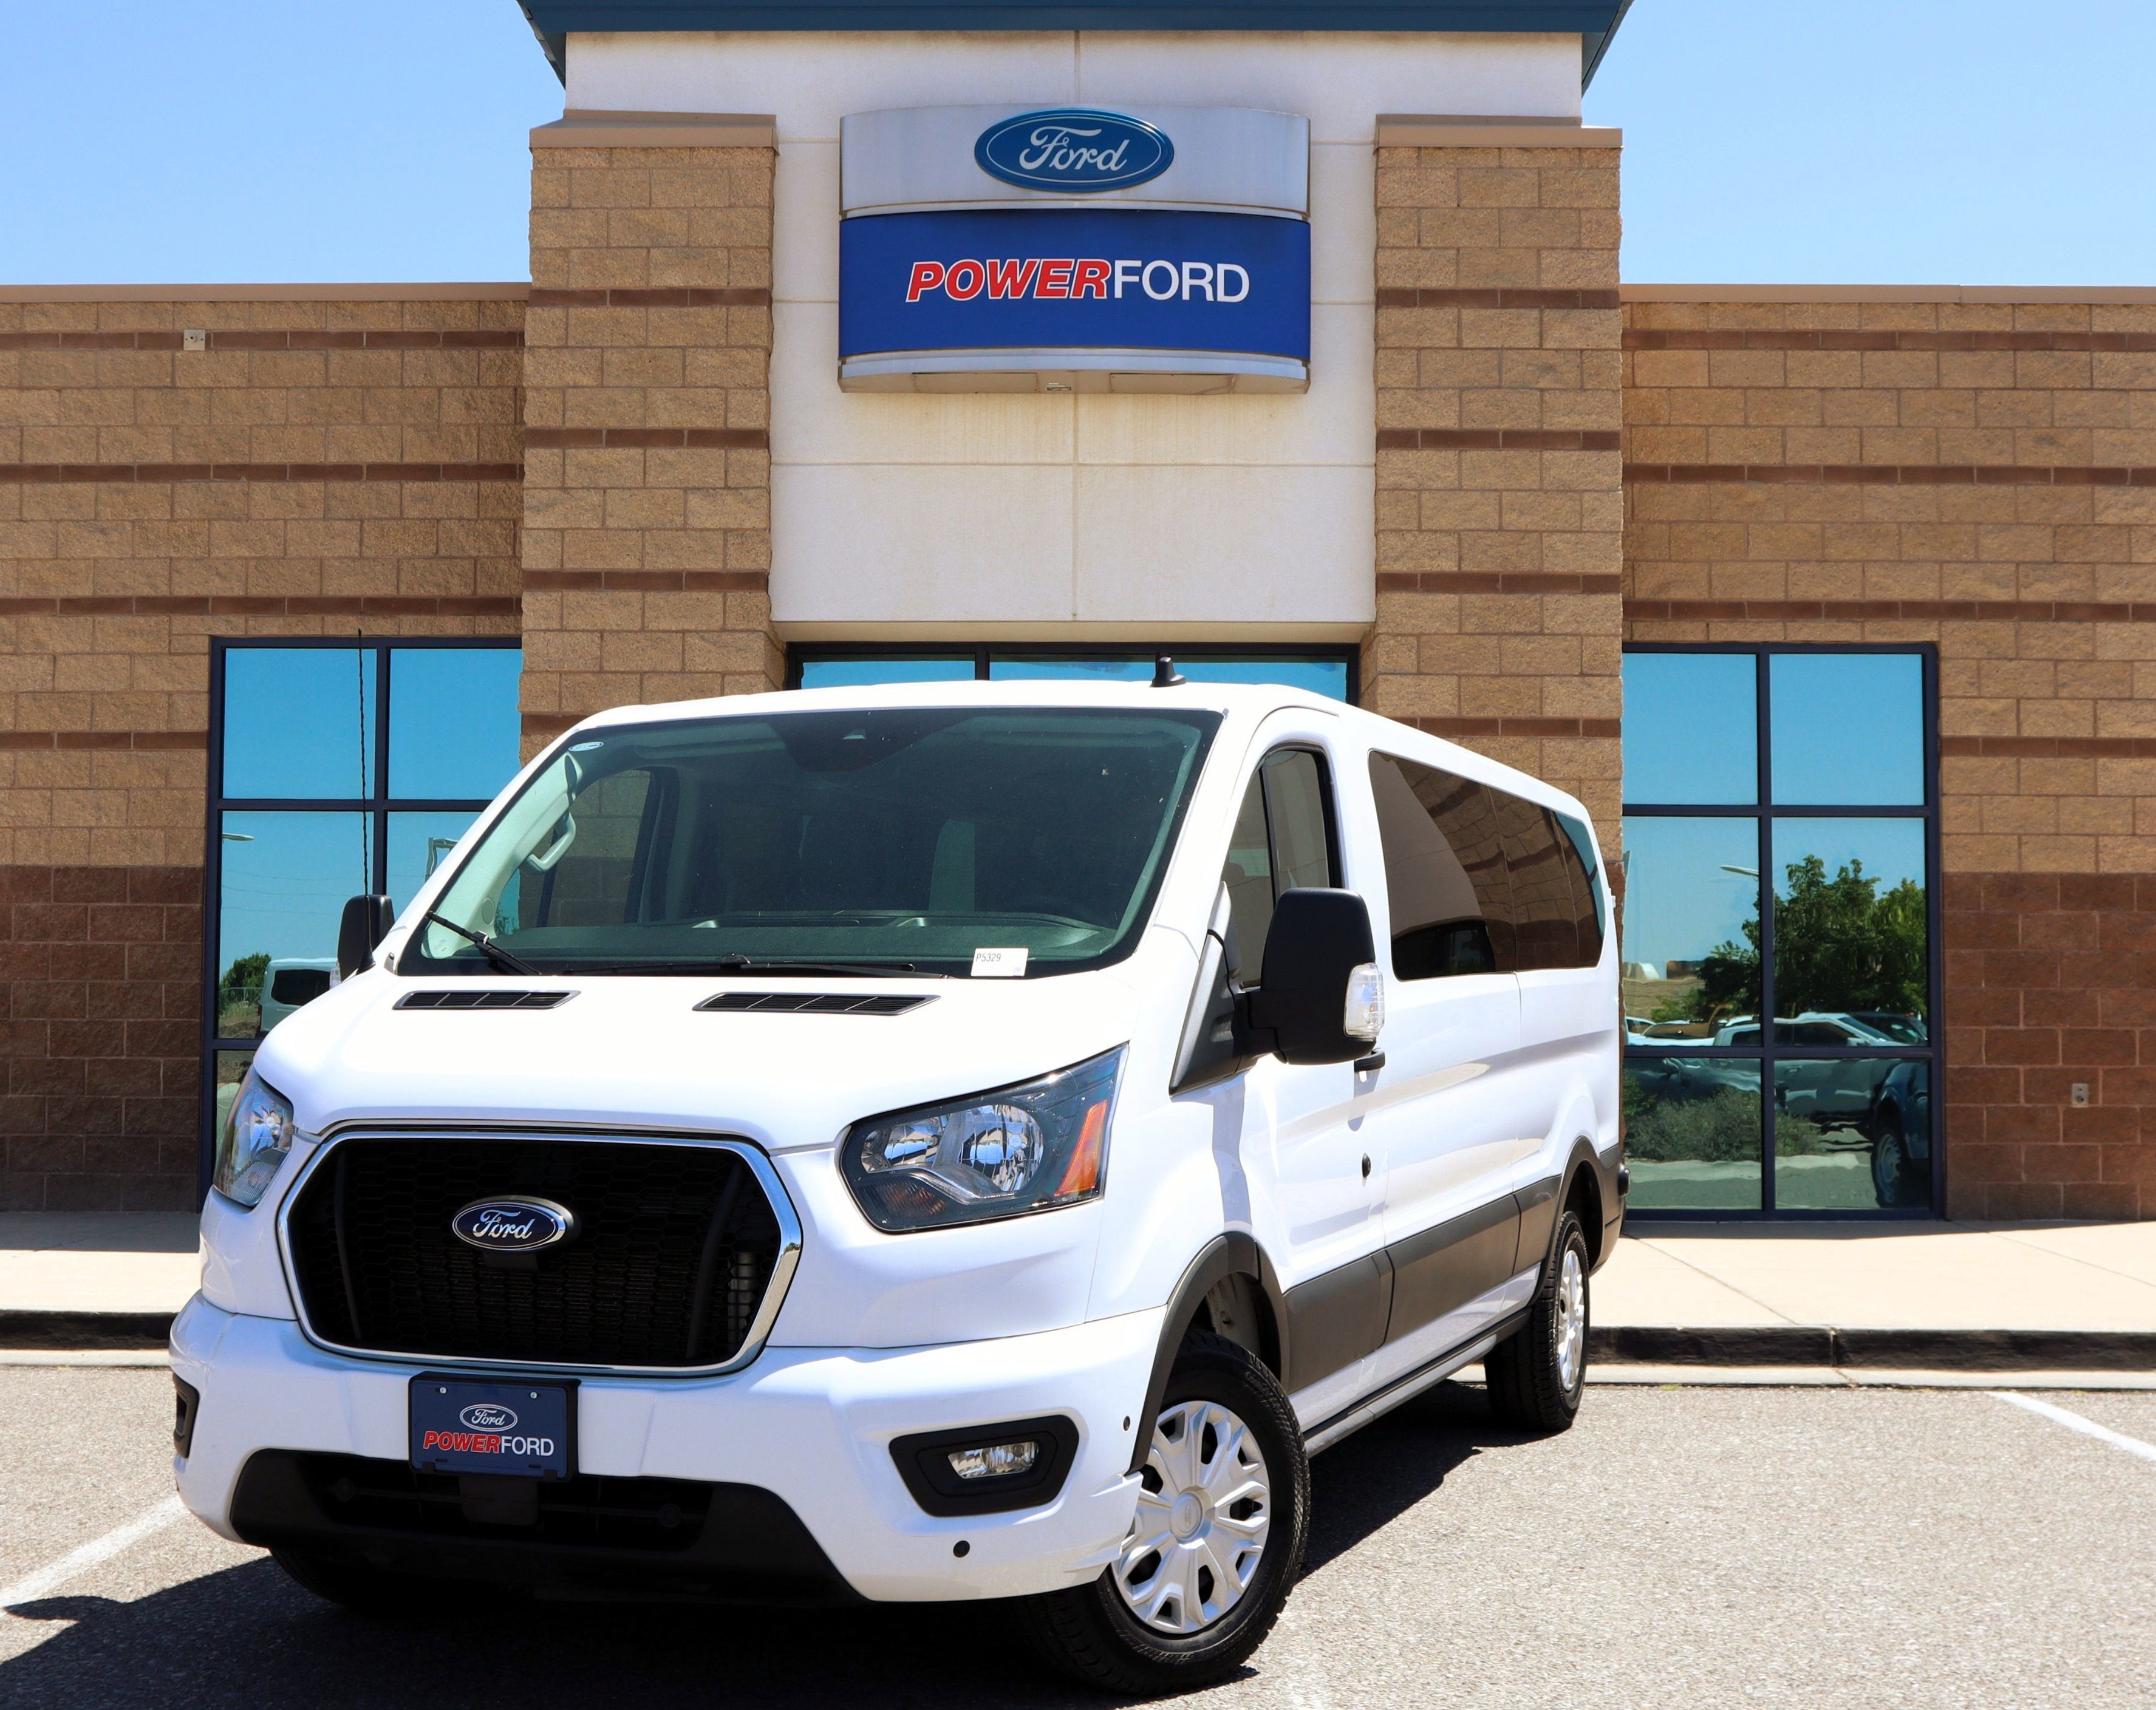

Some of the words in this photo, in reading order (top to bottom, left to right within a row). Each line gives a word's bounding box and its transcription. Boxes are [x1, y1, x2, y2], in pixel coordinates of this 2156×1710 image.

[1019, 125, 1130, 172] Ford
[976, 953, 1001, 962] P5329
[472, 1209, 536, 1239] Ford
[471, 1408, 506, 1426] Ford
